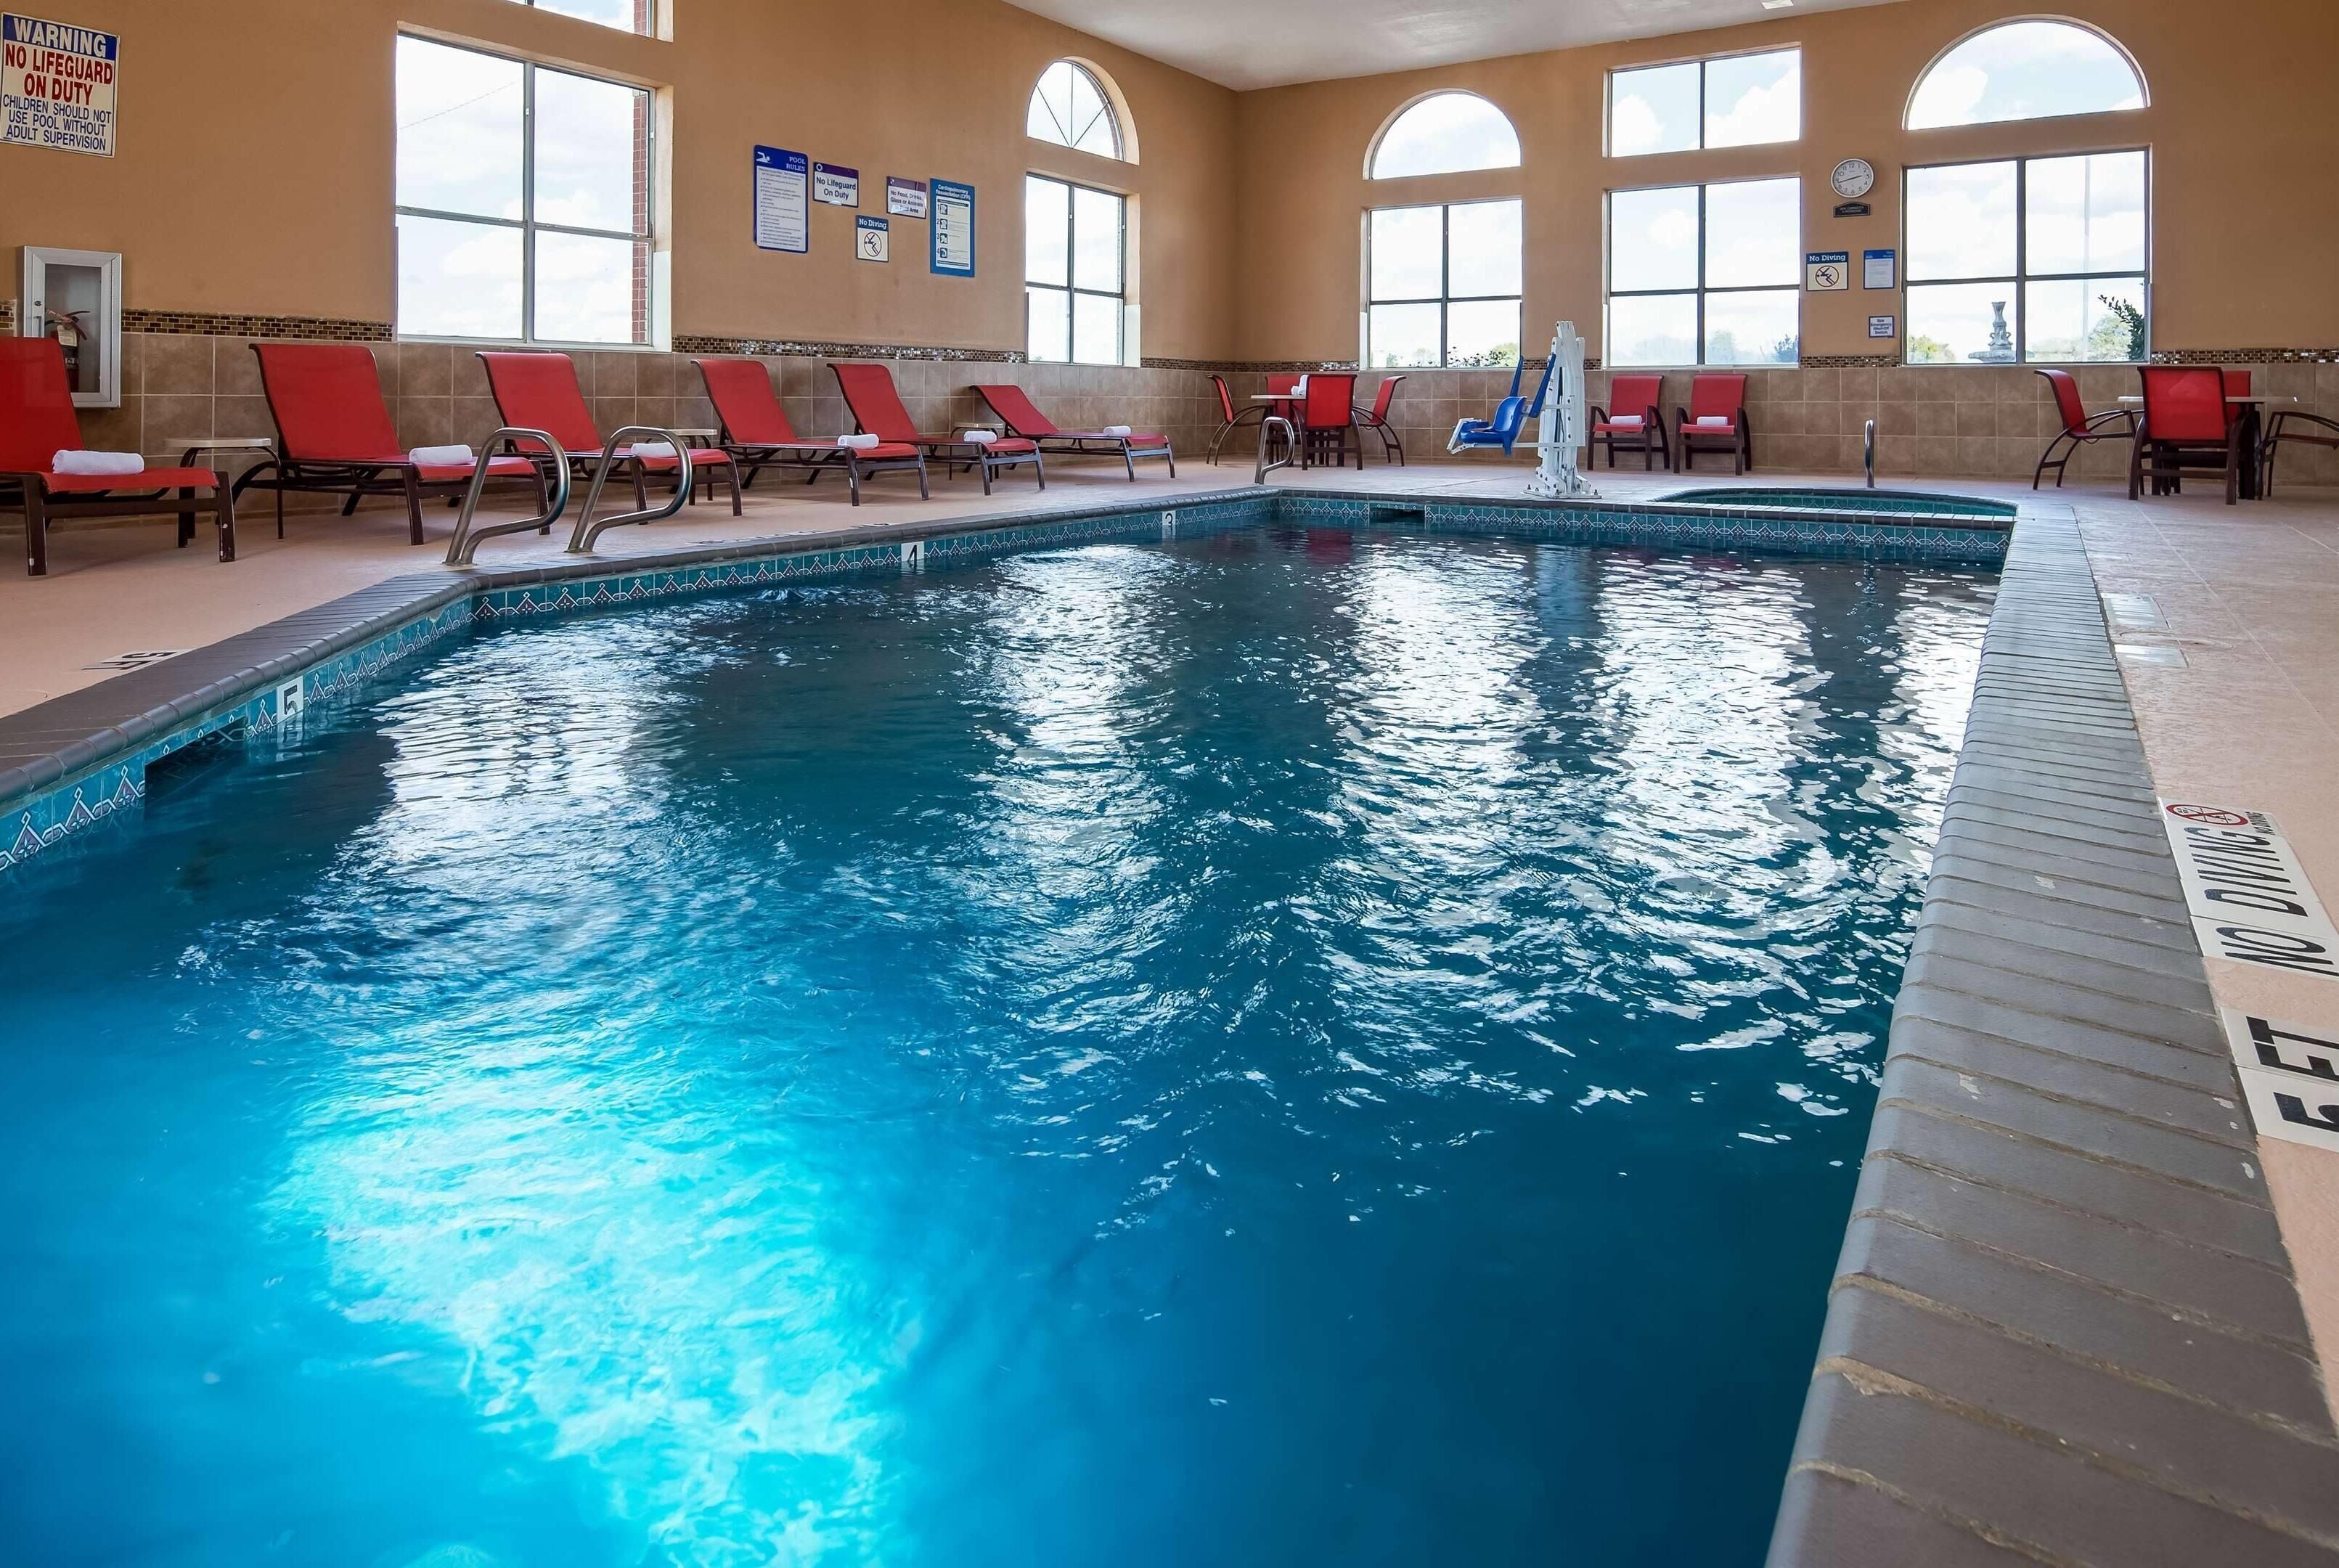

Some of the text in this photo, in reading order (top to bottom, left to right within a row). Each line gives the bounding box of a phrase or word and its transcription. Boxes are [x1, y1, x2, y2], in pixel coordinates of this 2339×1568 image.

[14, 17, 106, 57] WARNING
[6, 44, 113, 84] NO LIFEGUARD
[24, 73, 93, 105] ON DUTY
[3, 94, 112, 123] CHILDREN SHOULD NOT
[9, 110, 106, 136] USE POOL WITHOUT
[6, 124, 106, 151] ADULT SUPERVISION
[785, 163, 806, 172] RULES
[789, 156, 806, 165] POOL
[816, 176, 857, 190] No Lifeguard
[823, 188, 849, 200] On Duty
[868, 219, 887, 230] Diving
[2184, 827, 2339, 977] NO DIVING
